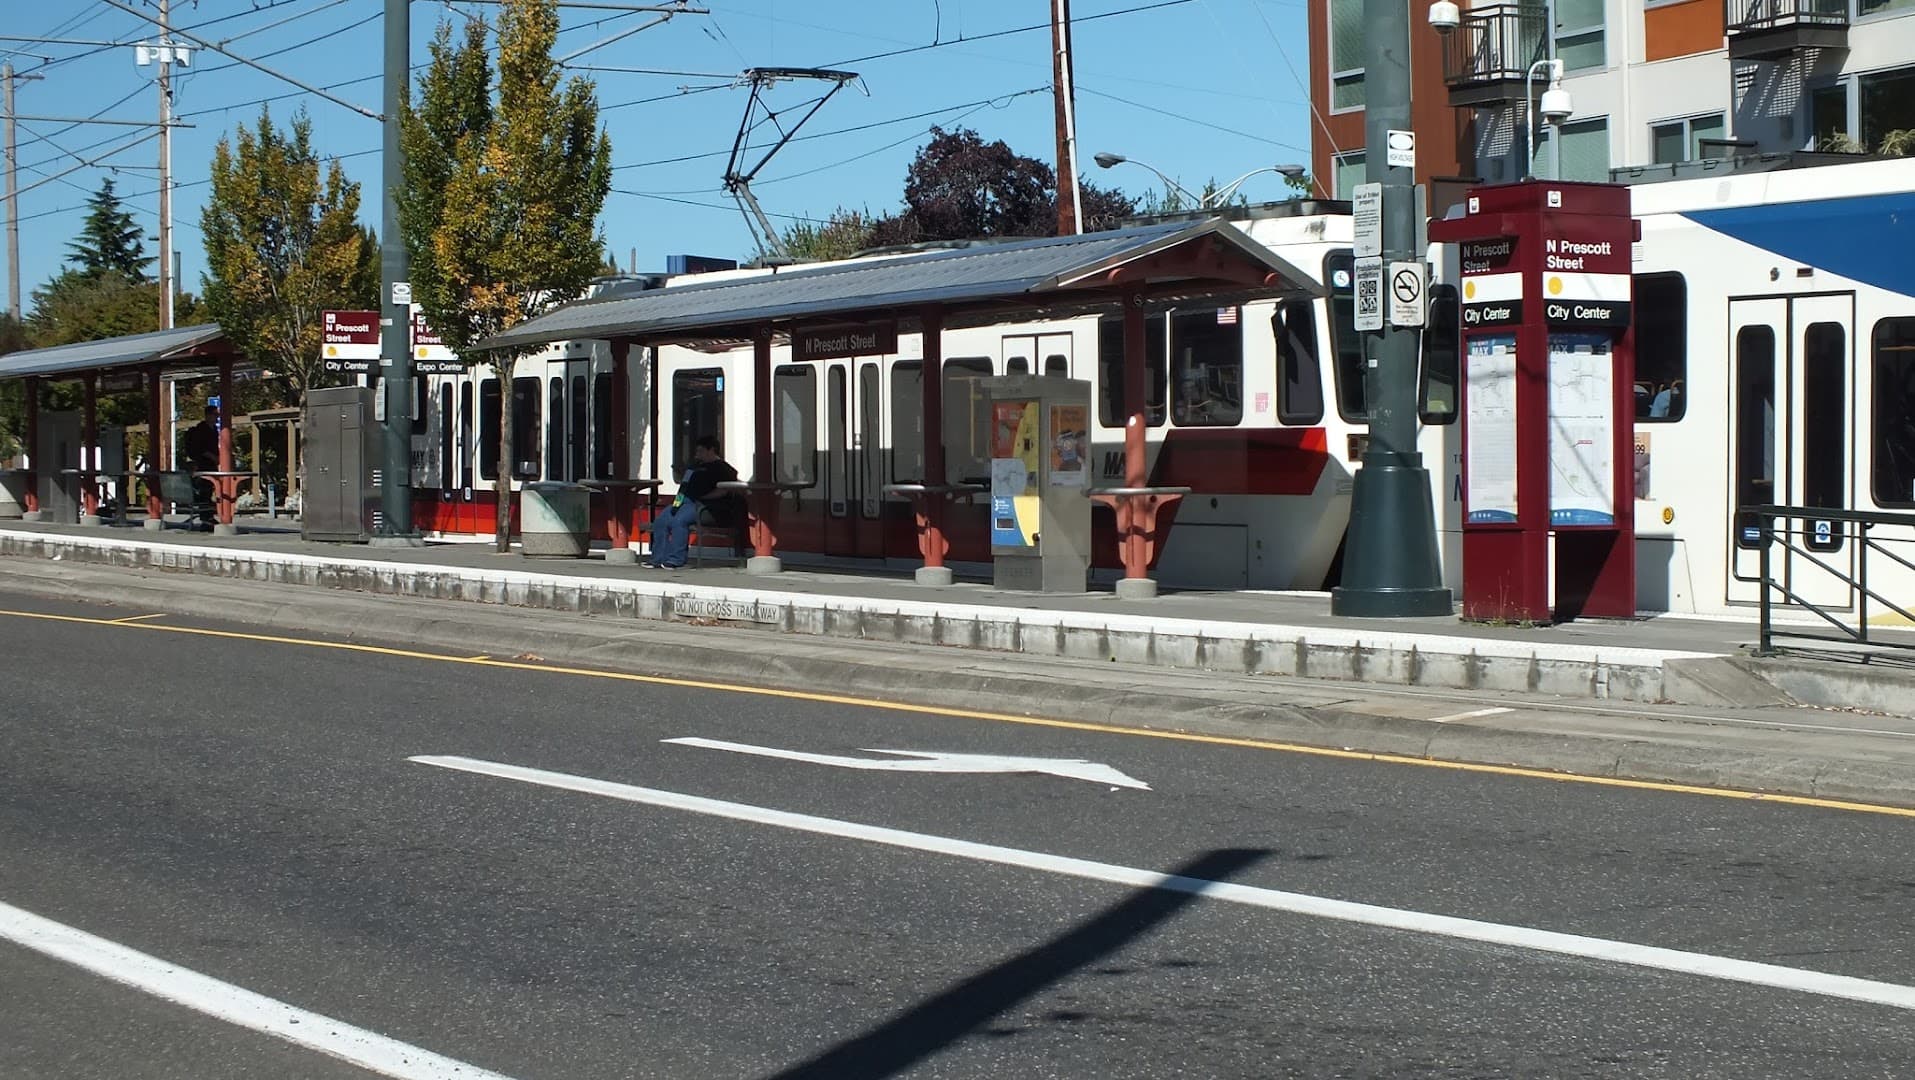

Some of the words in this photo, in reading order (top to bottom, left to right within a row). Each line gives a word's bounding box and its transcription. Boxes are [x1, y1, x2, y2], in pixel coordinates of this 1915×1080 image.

[1464, 246, 1471, 257] N
[1474, 242, 1510, 256] Prescott
[1547, 240, 1556, 253] N
[1561, 240, 1612, 255] Prescott
[1464, 260, 1490, 274] Street
[1547, 256, 1584, 270] Street
[1464, 309, 1480, 324] City
[1483, 307, 1510, 321] Center
[1547, 305, 1570, 321] City
[1574, 305, 1611, 320] Center
[335, 324, 369, 333] Prescott
[417, 325, 424, 333] N
[326, 335, 351, 343] Street
[417, 335, 441, 343] Street
[805, 338, 812, 353] N
[814, 336, 848, 352] Prescott
[850, 333, 876, 350] Street
[326, 362, 341, 371] City
[344, 361, 369, 370] Center
[417, 362, 436, 372] Expo
[439, 362, 463, 371] Center
[676, 600, 685, 612] DO
[689, 601, 704, 614] NOT
[707, 602, 731, 616] CROSS
